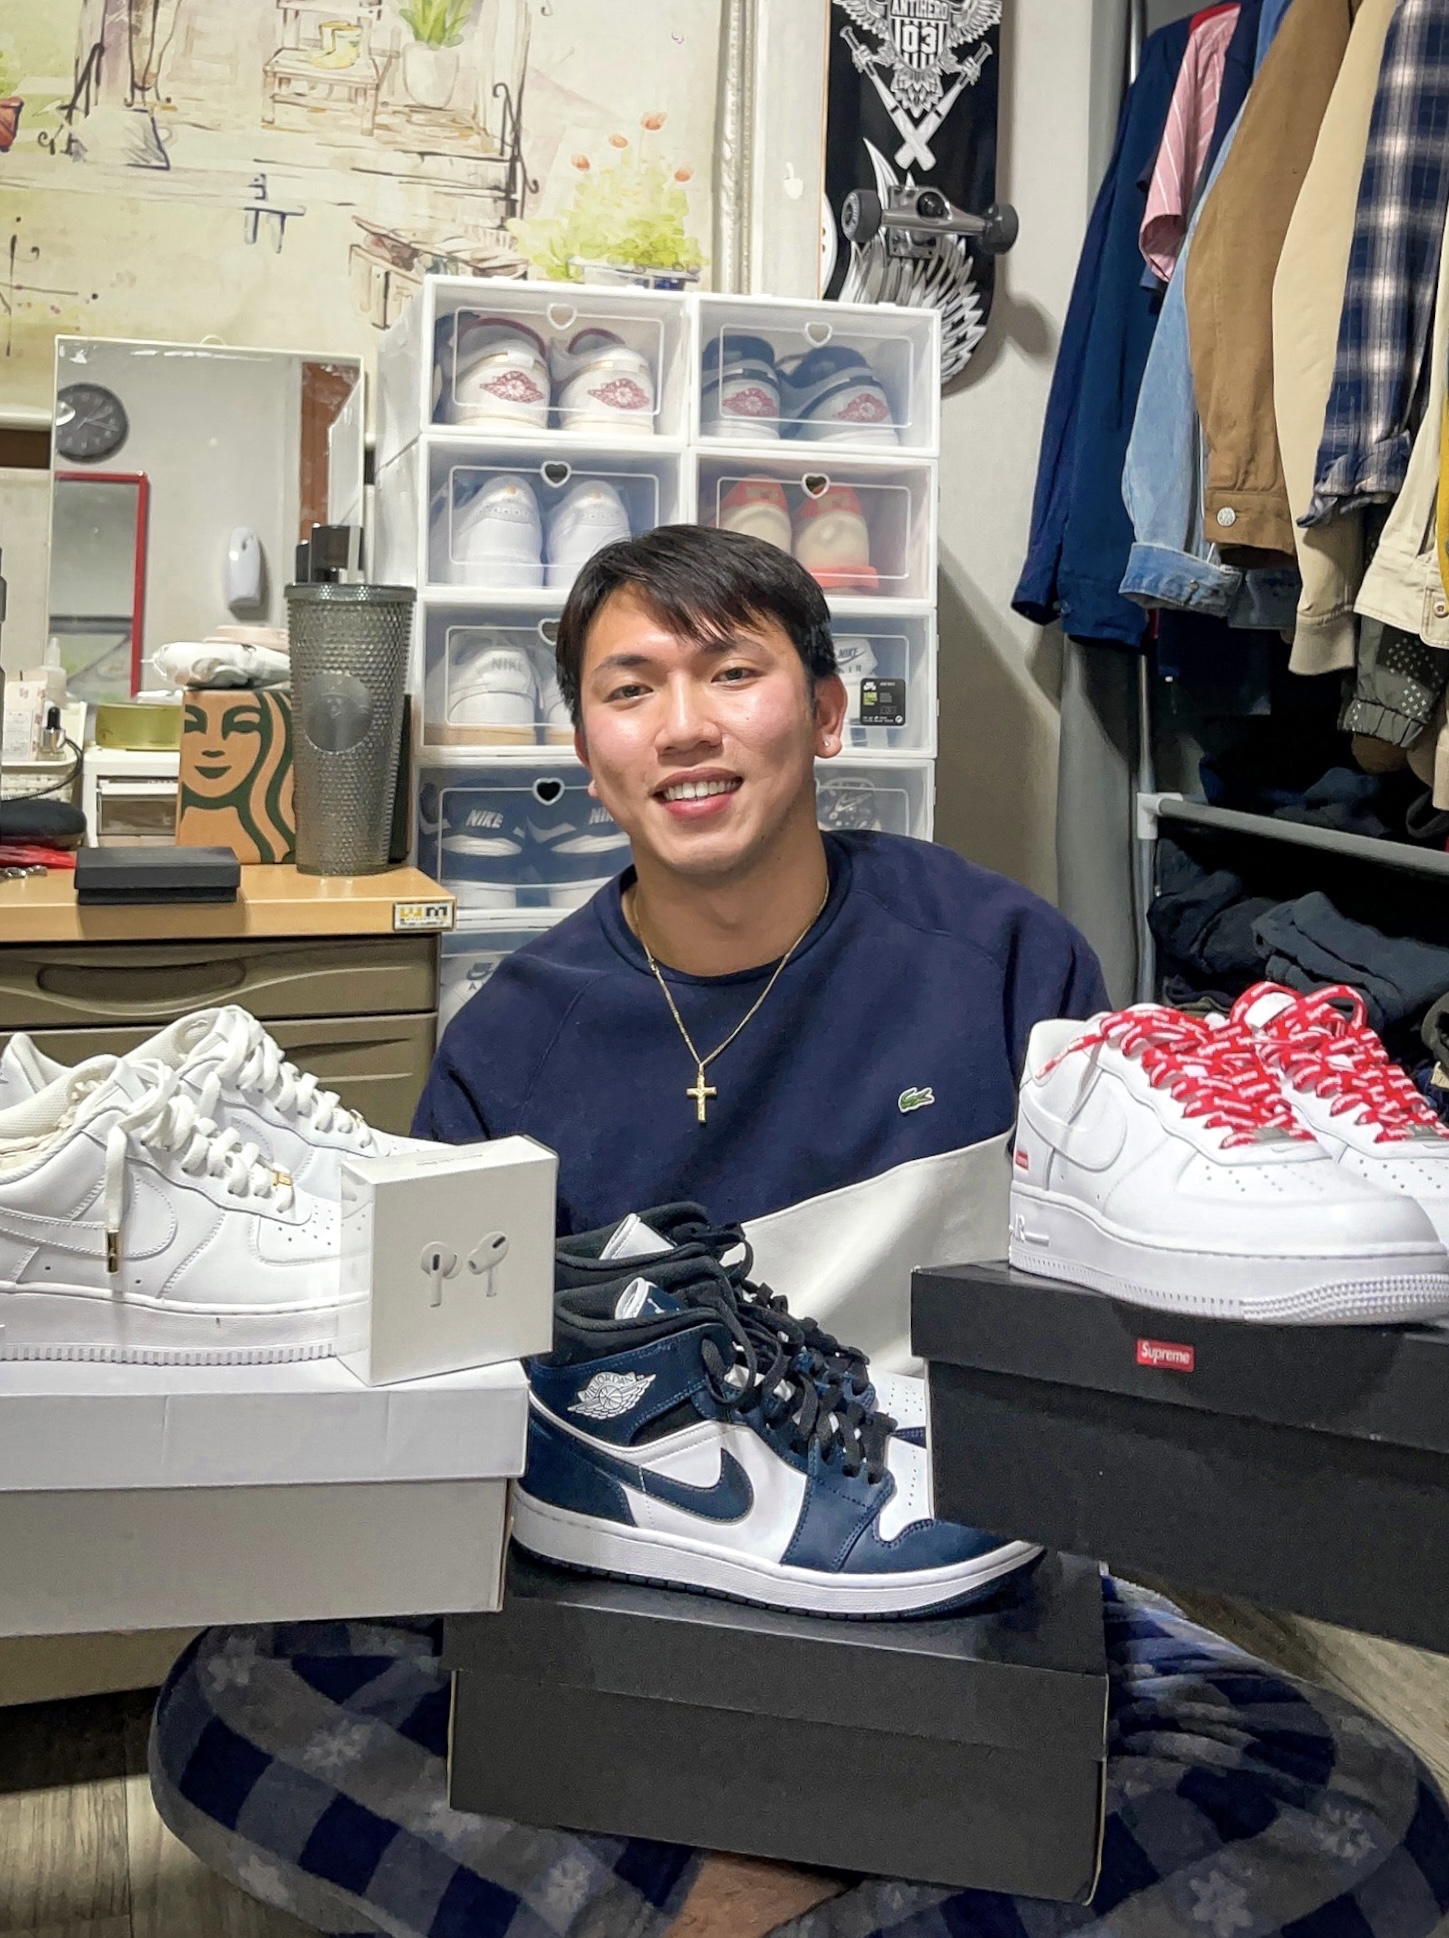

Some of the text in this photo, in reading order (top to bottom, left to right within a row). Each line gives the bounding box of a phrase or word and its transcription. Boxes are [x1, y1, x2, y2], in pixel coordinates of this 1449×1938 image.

[902, 25, 937, 54] 03
[465, 809, 504, 829] NIKE
[588, 807, 615, 825] NIK
[1141, 1340, 1190, 1365] Supreme
[583, 1373, 635, 1400] AIR JORDAN
